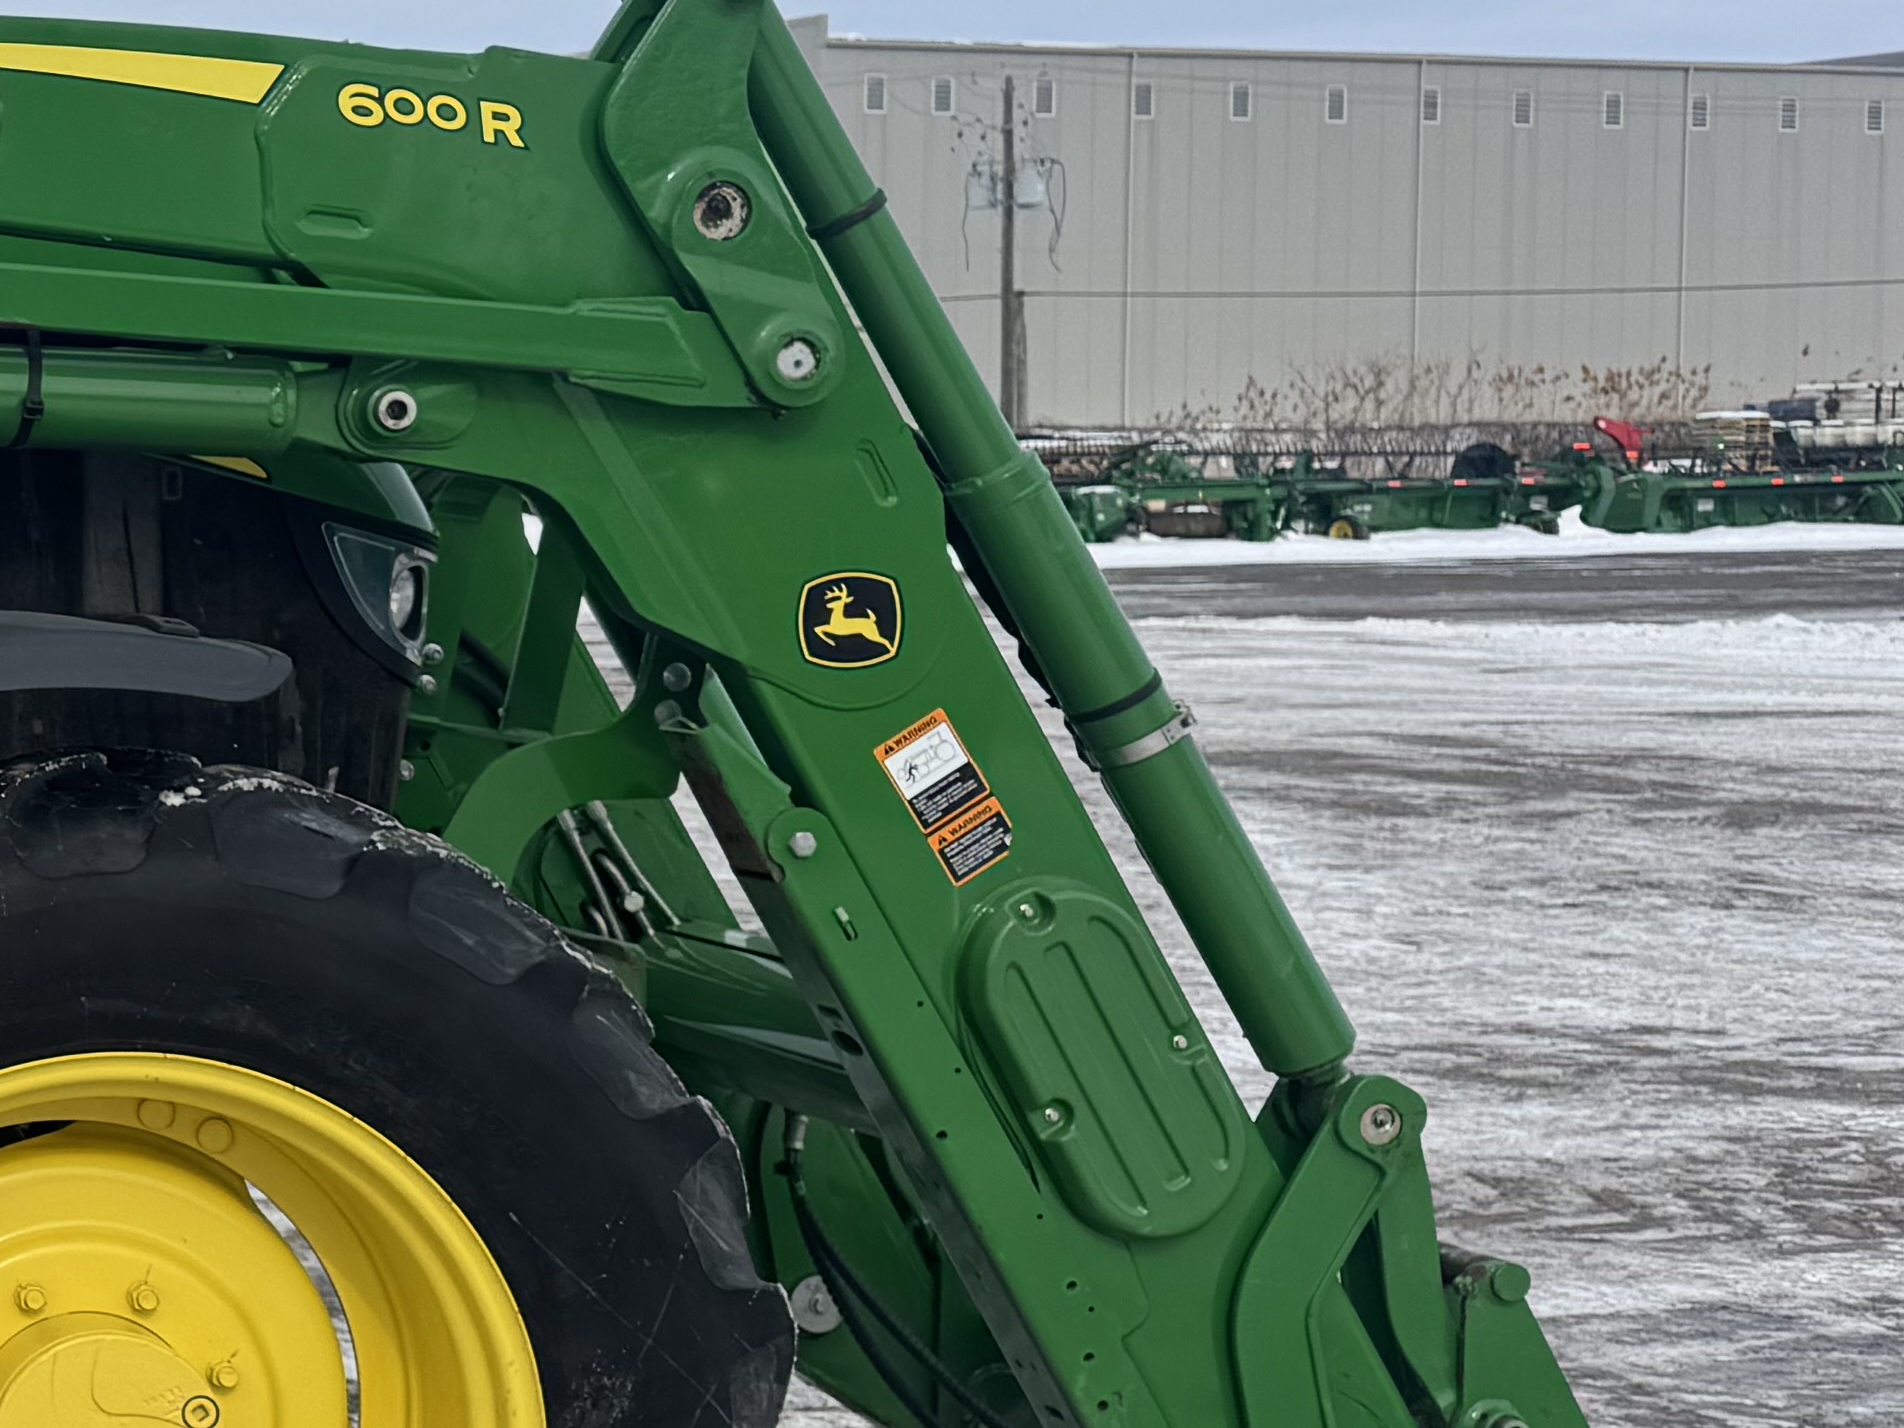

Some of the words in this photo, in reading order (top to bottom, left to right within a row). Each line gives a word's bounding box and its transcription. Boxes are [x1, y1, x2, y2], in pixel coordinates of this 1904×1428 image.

[337, 82, 468, 132] 600
[478, 99, 527, 150] R
[893, 716, 938, 749] WARNING
[948, 805, 992, 836] WARNING
